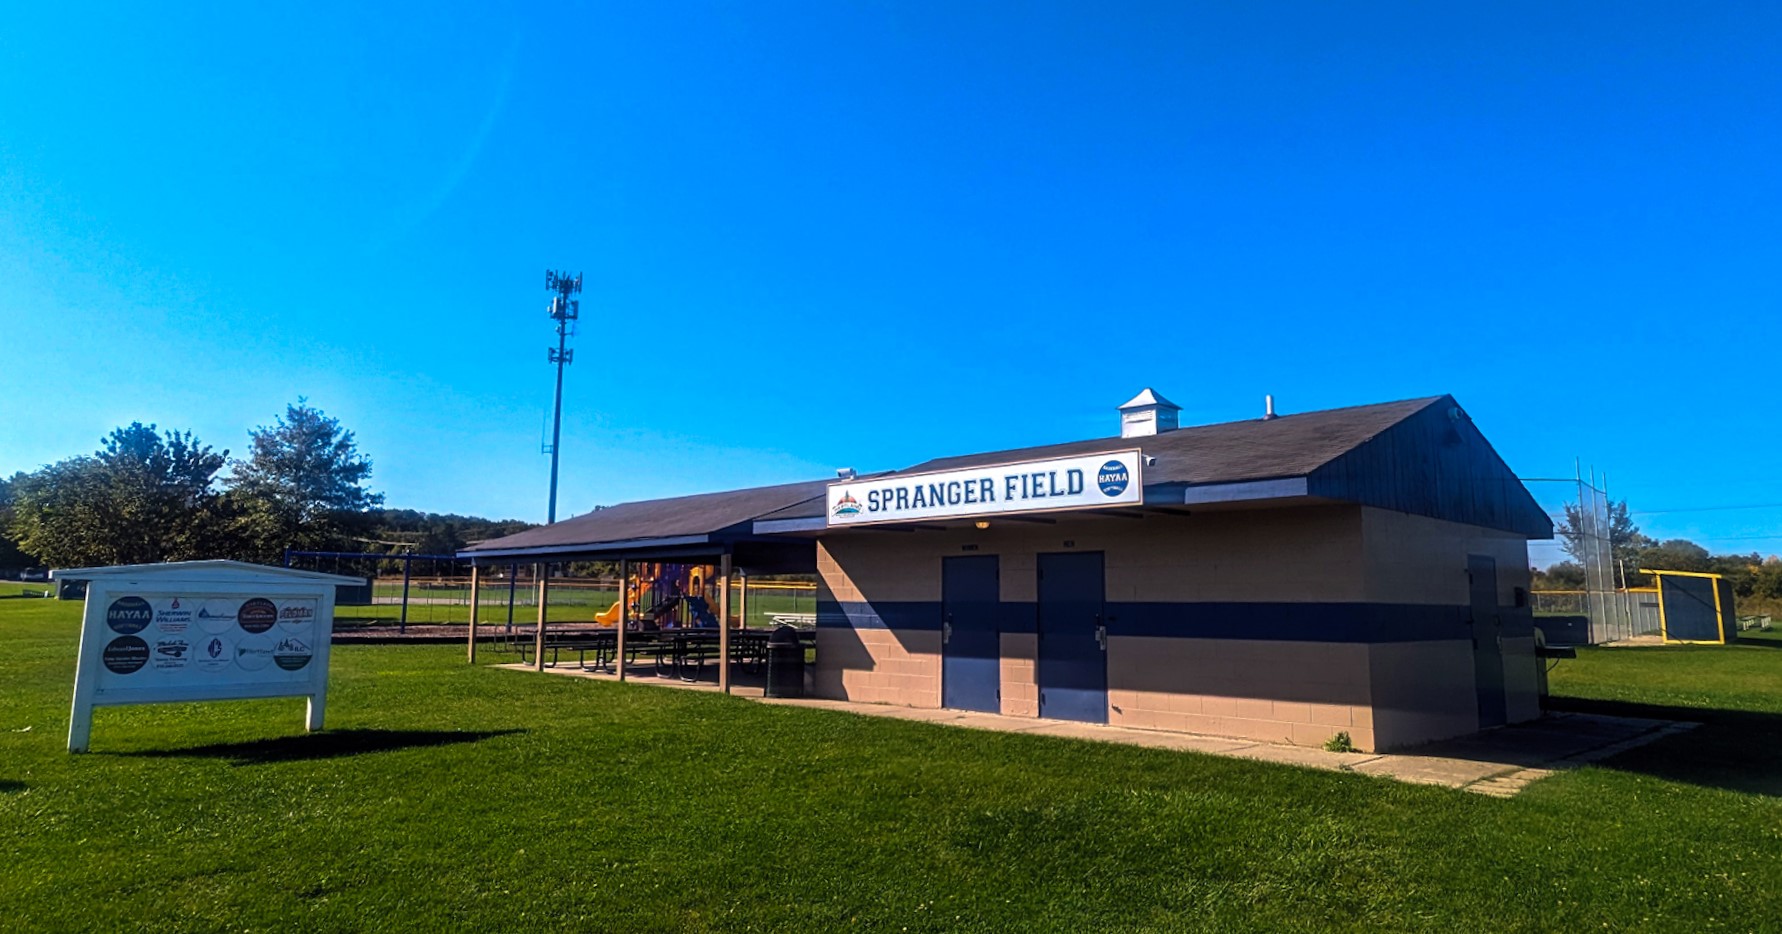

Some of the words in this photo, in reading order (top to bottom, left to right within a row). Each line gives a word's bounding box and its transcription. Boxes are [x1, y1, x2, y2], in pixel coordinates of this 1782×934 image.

[1099, 472, 1128, 484] HAYAA
[868, 478, 995, 512] SPRANGER
[1004, 469, 1084, 501] FIELD
[108, 609, 150, 619] HAYAA
